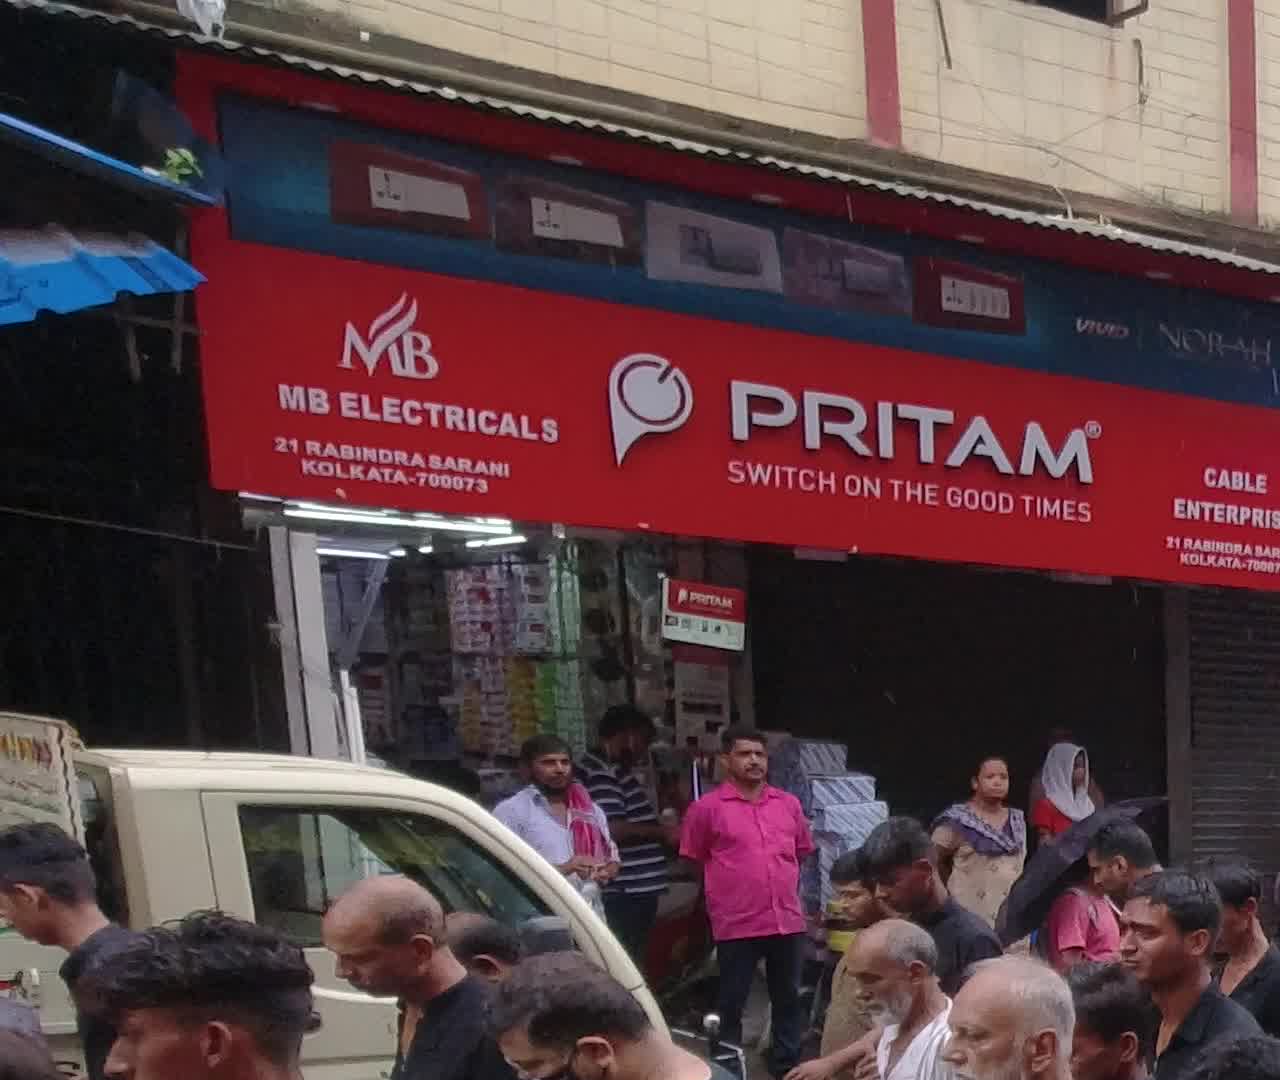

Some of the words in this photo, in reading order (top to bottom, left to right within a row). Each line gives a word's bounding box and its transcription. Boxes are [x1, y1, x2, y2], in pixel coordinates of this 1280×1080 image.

[278, 383, 329, 415] MB
[340, 392, 559, 443] ELECTRICALS
[730, 380, 1094, 484] PRITAM
[273, 437, 298, 453] 21
[305, 439, 426, 469] RABINDRA
[428, 455, 511, 478] SARANI
[301, 458, 489, 494] KOLKATA-700073
[727, 460, 836, 495] SWITCH
[844, 475, 881, 498] ON
[889, 480, 940, 506] THE
[946, 487, 1014, 515] GOOD
[1020, 495, 1092, 524] TIMES
[1204, 467, 1267, 494] CABLE
[1166, 536, 1181, 550] 21
[1183, 537, 1253, 557] RABINDRA
[689, 591, 735, 609] PRITAM
